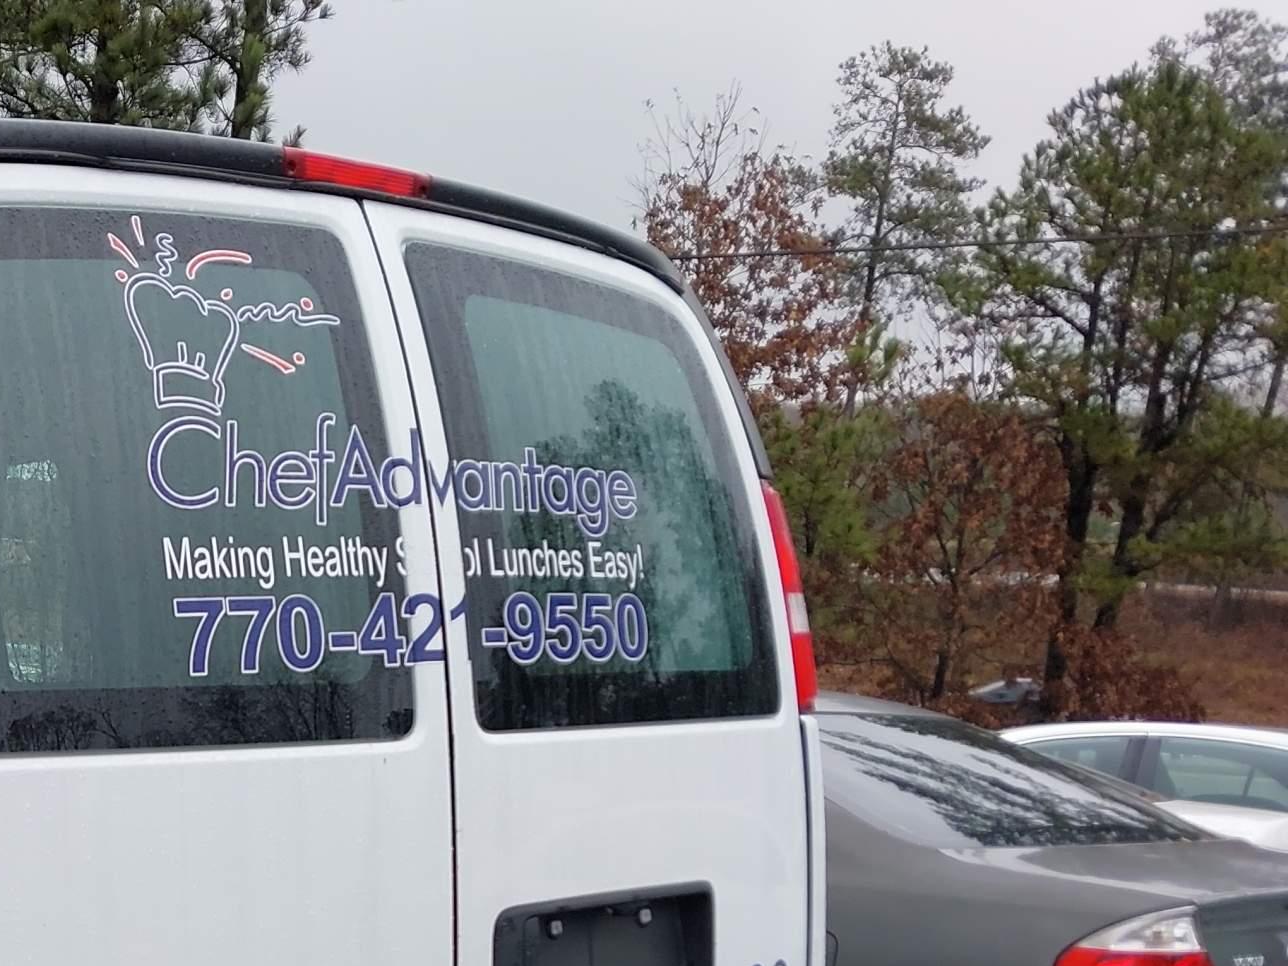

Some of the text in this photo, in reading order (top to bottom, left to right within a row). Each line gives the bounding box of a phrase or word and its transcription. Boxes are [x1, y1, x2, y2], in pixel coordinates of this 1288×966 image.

[147, 412, 638, 537] ChefAdvantage
[162, 536, 275, 589] Making
[282, 535, 388, 587] Healthy
[487, 538, 584, 578] Lunches
[587, 540, 645, 590] Easy!
